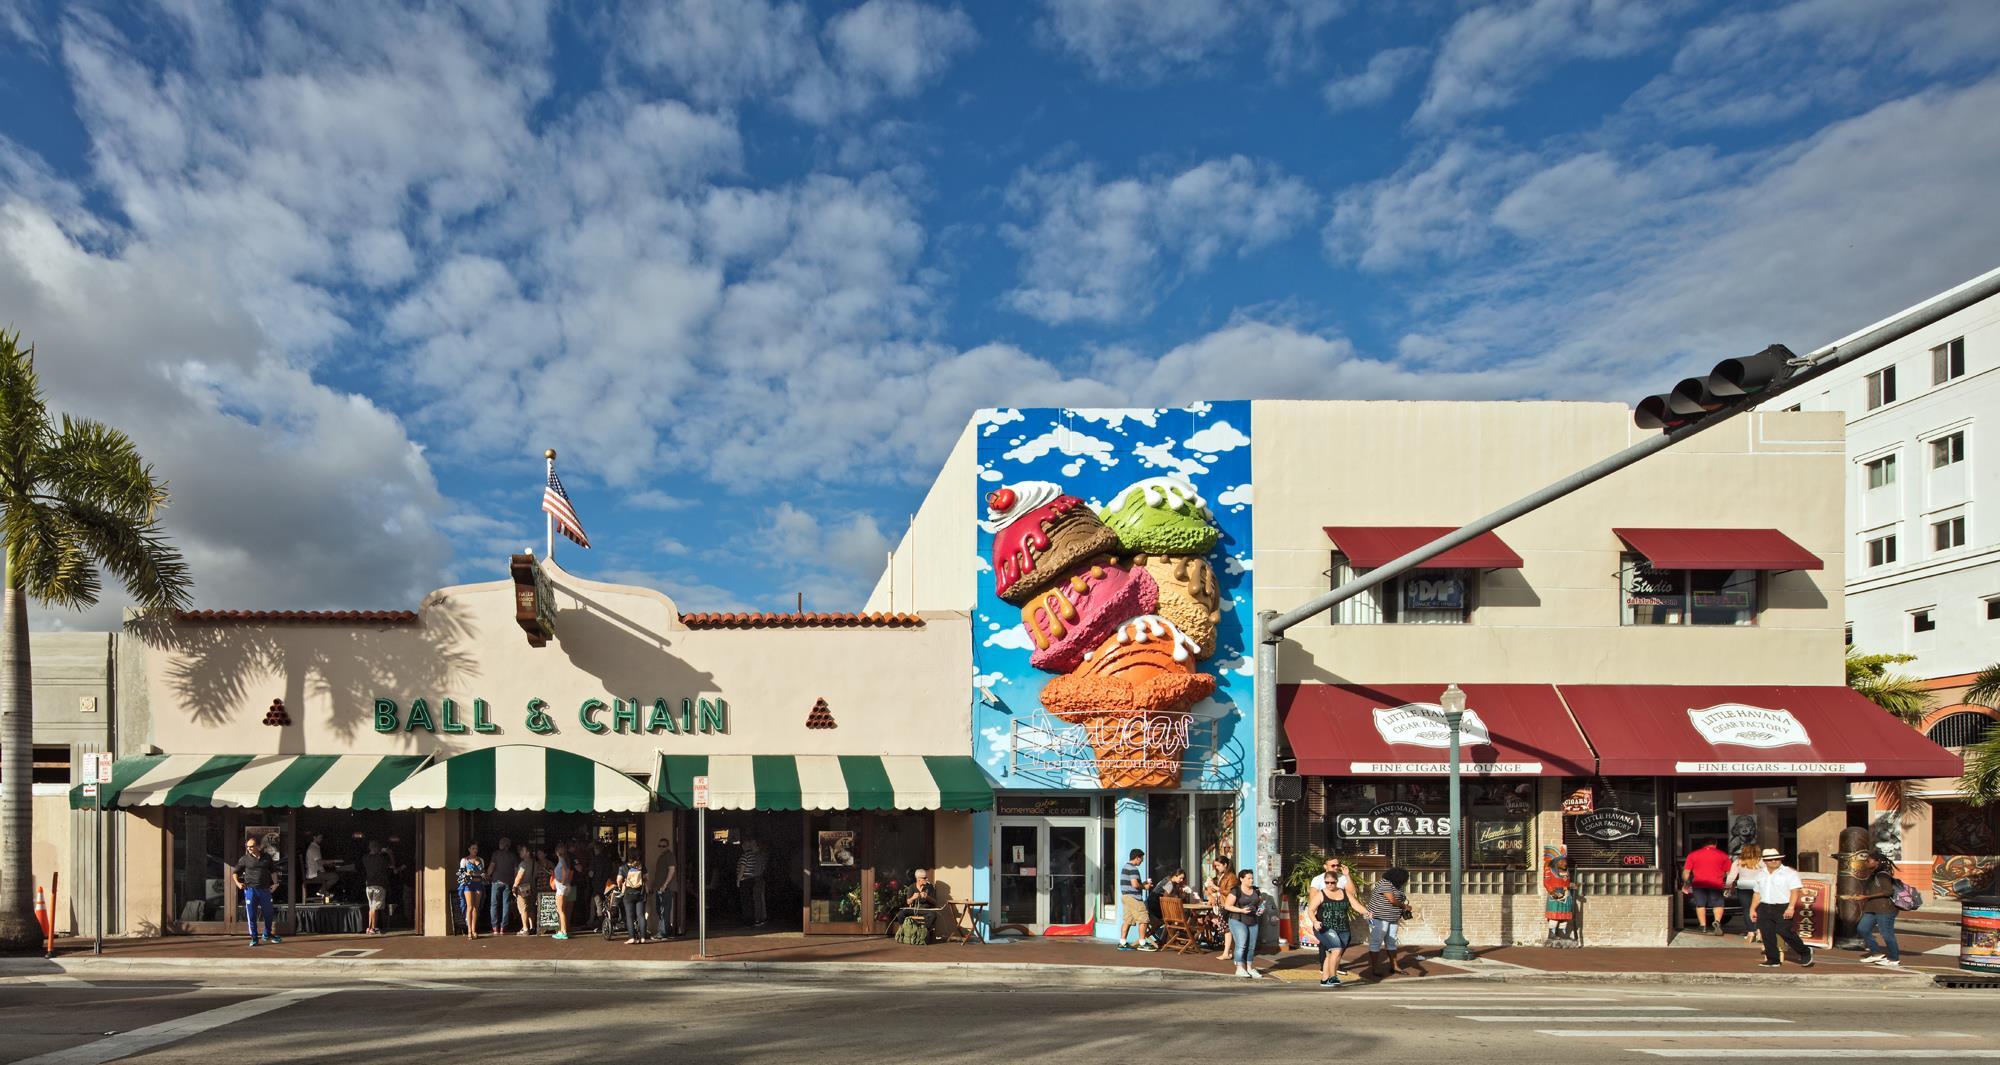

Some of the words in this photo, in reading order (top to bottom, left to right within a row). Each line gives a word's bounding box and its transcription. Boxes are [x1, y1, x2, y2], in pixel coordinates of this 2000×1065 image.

[1630, 577, 1673, 593] Studio
[374, 697, 498, 734] BALL
[525, 697, 552, 733] &
[578, 697, 725, 733] CHAIN
[1382, 709, 1421, 726] LITTLE
[1701, 709, 1737, 726] LITTLE
[1737, 709, 1792, 726] HAVANA
[1393, 721, 1420, 734] CIGAR
[1712, 720, 1737, 734] CIGAR
[1739, 720, 1791, 735] FACTORY
[1114, 759, 1180, 774] company
[1372, 764, 1402, 772] FINE
[1466, 764, 1522, 772] LOUNGE
[1698, 763, 1728, 772] FINE
[1732, 763, 1780, 772] CIGARS
[1791, 763, 1846, 772] LOUNGE
[1564, 798, 1588, 806] CIGARS
[1340, 817, 1451, 836] CIGARS
[1581, 813, 1605, 826] LITTLE
[1605, 813, 1635, 826] HAVANA
[1585, 821, 1603, 831] CIGAR
[1604, 820, 1632, 831] FACTORY
[1480, 824, 1522, 842] Handmade
[1498, 840, 1523, 850] CIGARS
[1623, 855, 1645, 865] OPEN
[1799, 896, 1815, 938] CIGARS
